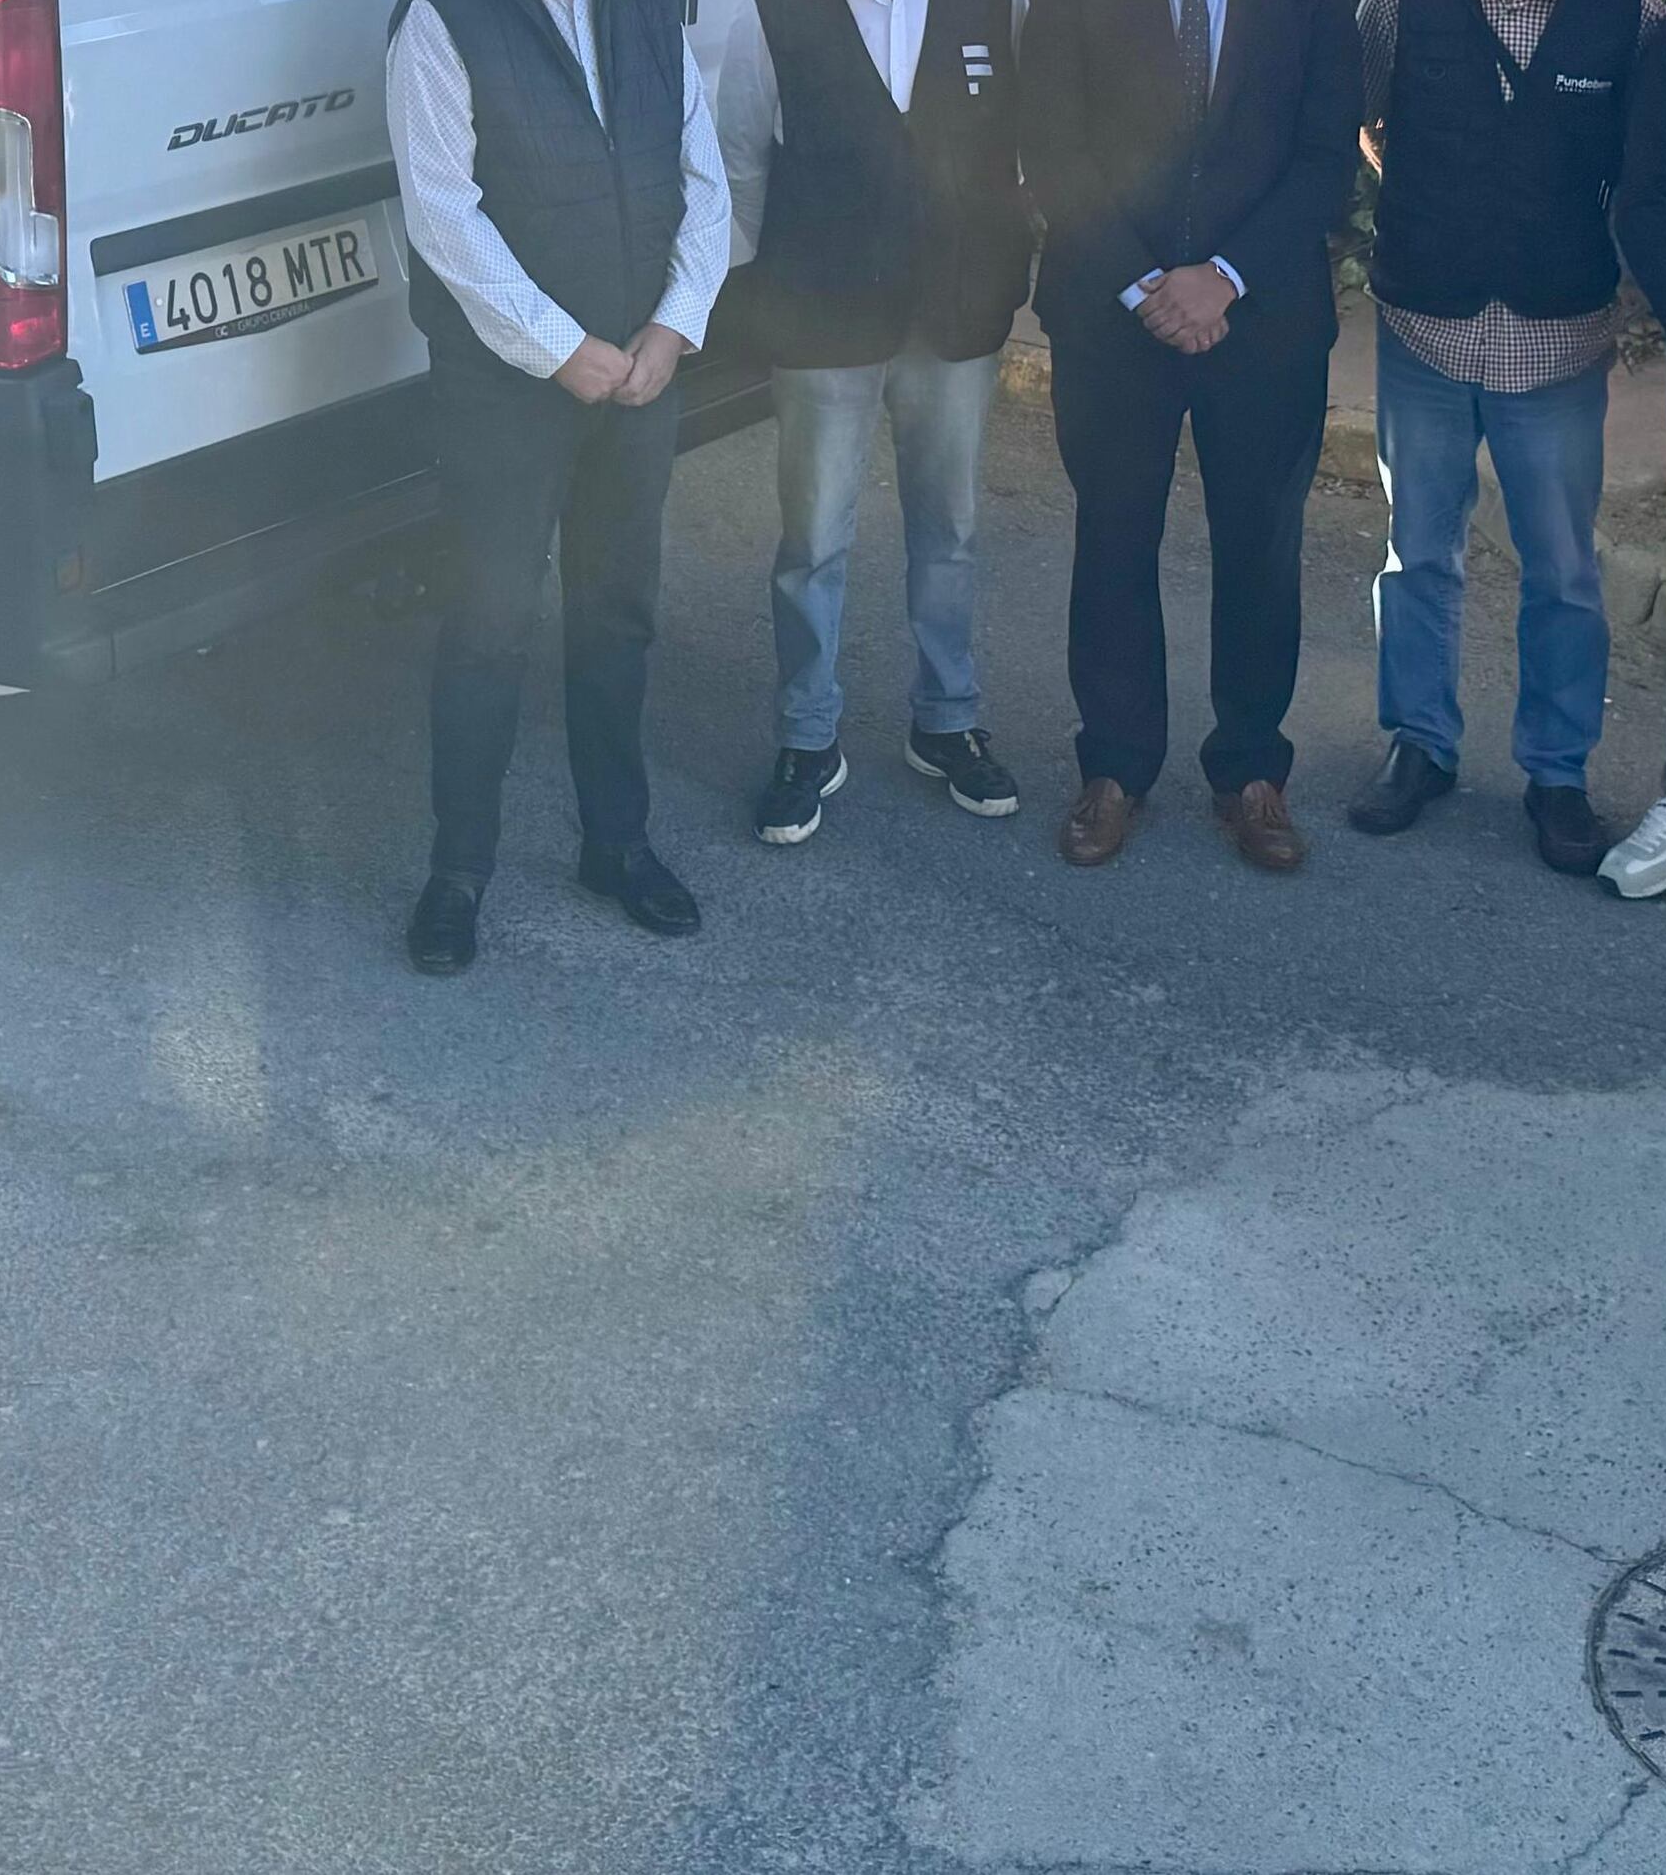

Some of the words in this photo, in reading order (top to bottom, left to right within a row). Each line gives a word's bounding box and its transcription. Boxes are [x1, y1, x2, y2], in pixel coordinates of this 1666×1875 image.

[167, 87, 356, 152] DUCATO
[166, 255, 273, 332] 4018
[282, 230, 366, 299] MTR
[140, 322, 152, 338] E
